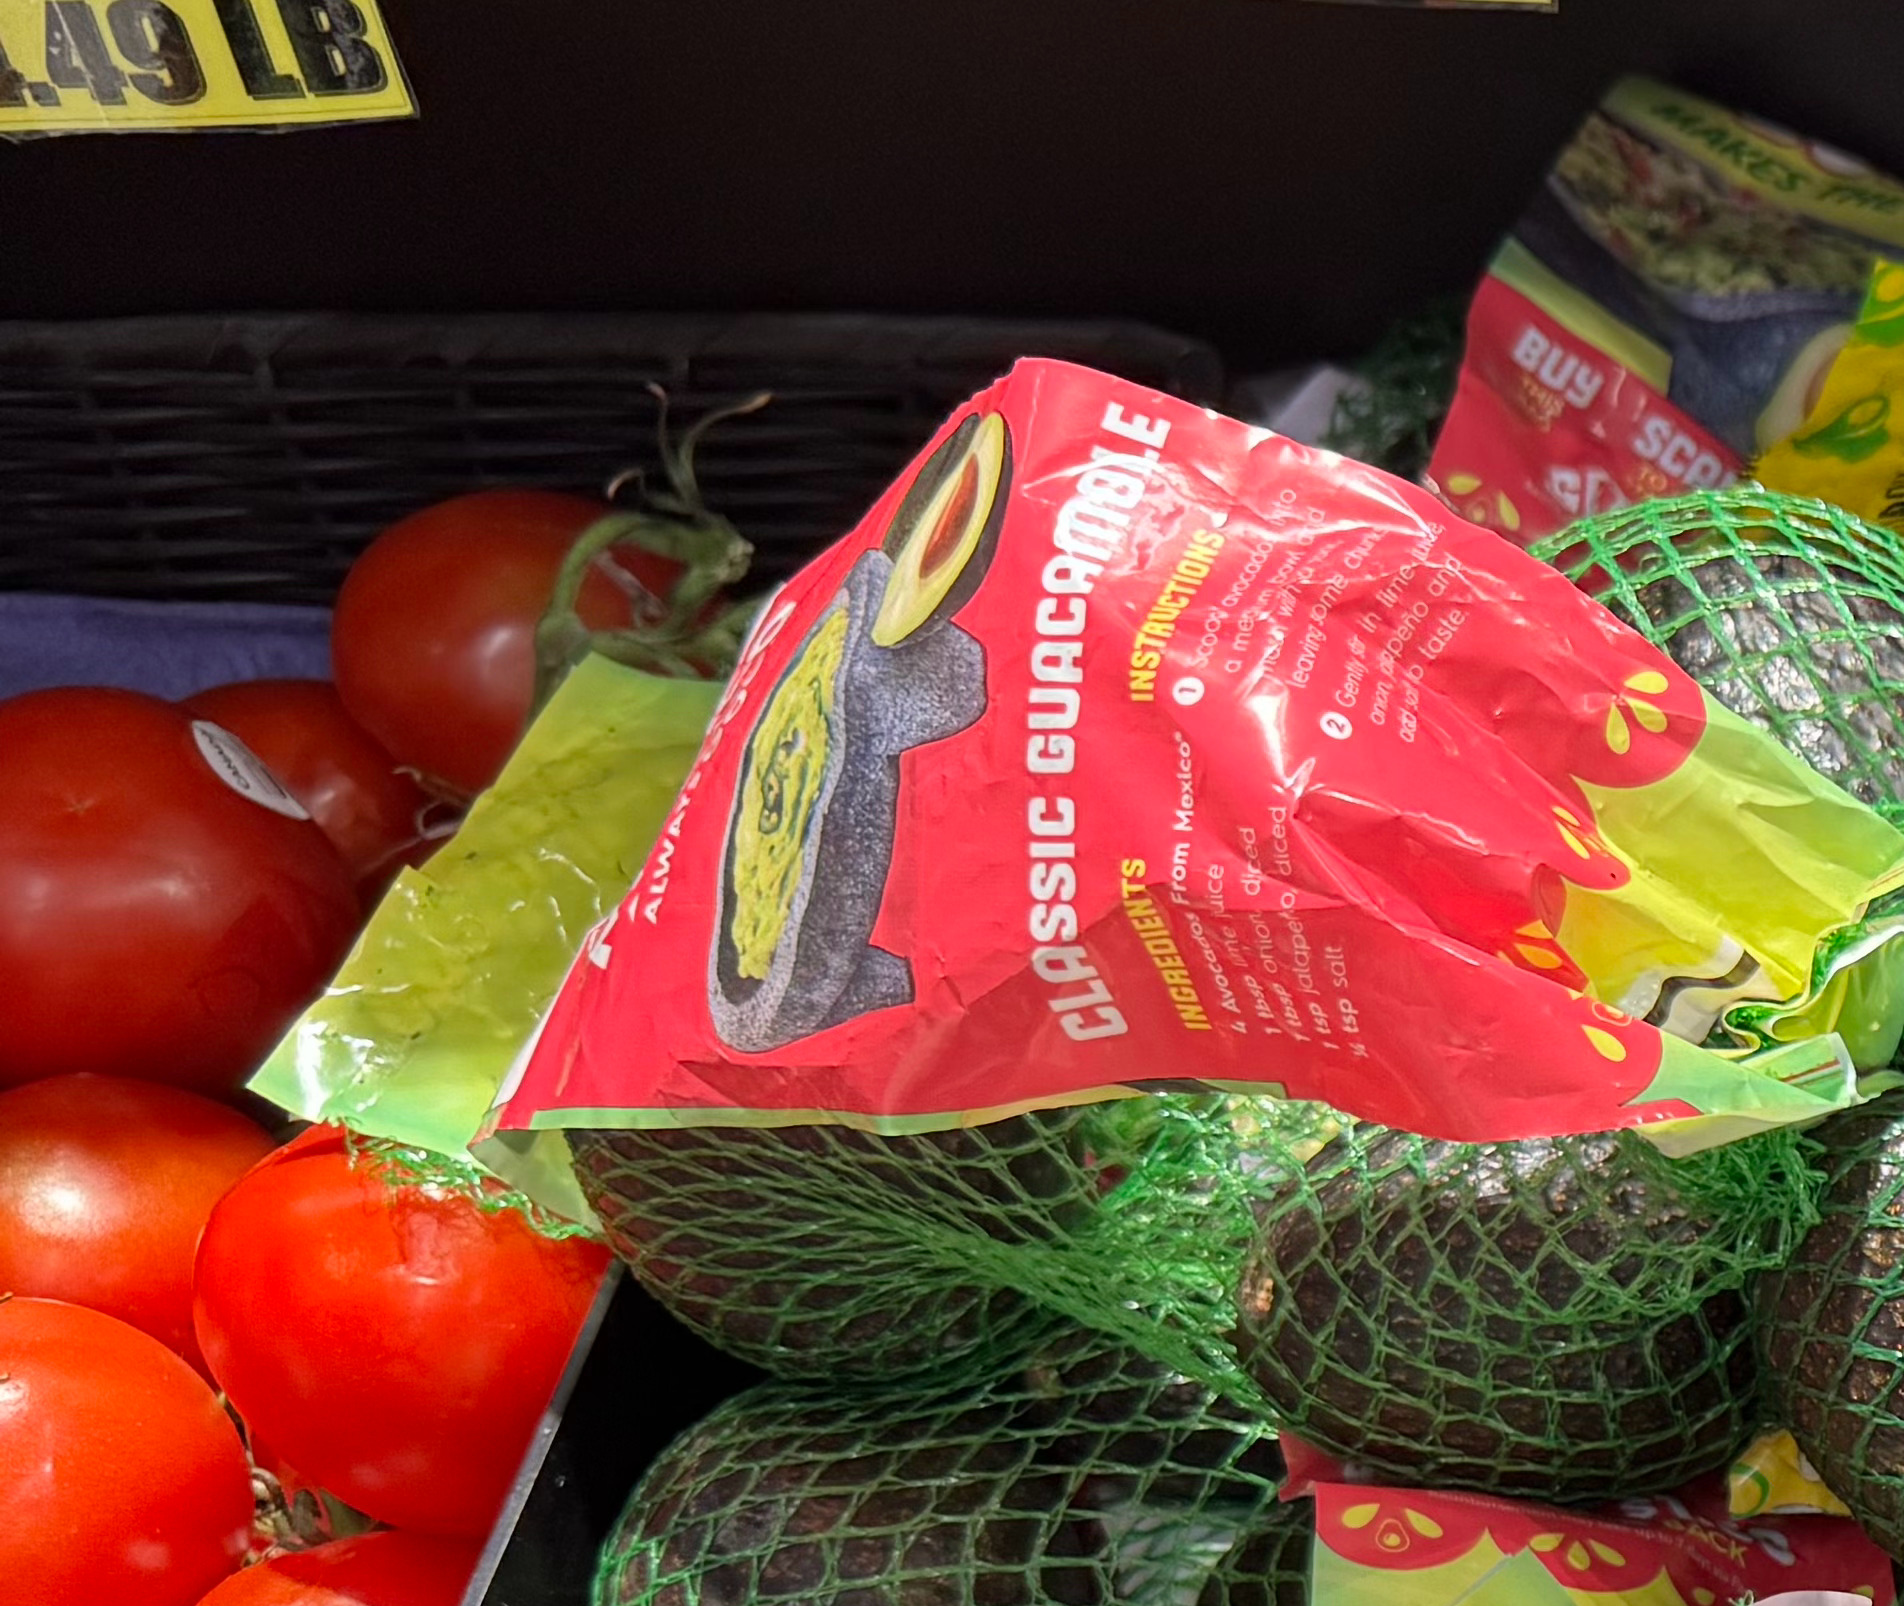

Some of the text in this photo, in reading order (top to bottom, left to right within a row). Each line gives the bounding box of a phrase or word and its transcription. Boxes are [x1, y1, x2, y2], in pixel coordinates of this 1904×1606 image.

[212, 0, 388, 101] LB
[1511, 323, 1604, 410] BUY
[1129, 528, 1225, 702] INSTRUCTIONS
[1284, 624, 1327, 689] leaving
[1310, 573, 1349, 627] some
[1026, 401, 1172, 1043] CLASSIC GUACAMOLE
[1171, 843, 1191, 905] From
[1268, 806, 1292, 877] diced
[1120, 857, 1212, 1030] INGREDIENTS
[1181, 911, 1240, 1014] Avocados
[1325, 946, 1348, 989] salt
[1243, 974, 1275, 1019] tbsp
[1271, 982, 1302, 1028] tbsp
[1308, 1001, 1332, 1035] tsp
[1338, 998, 1359, 1033] tsp
